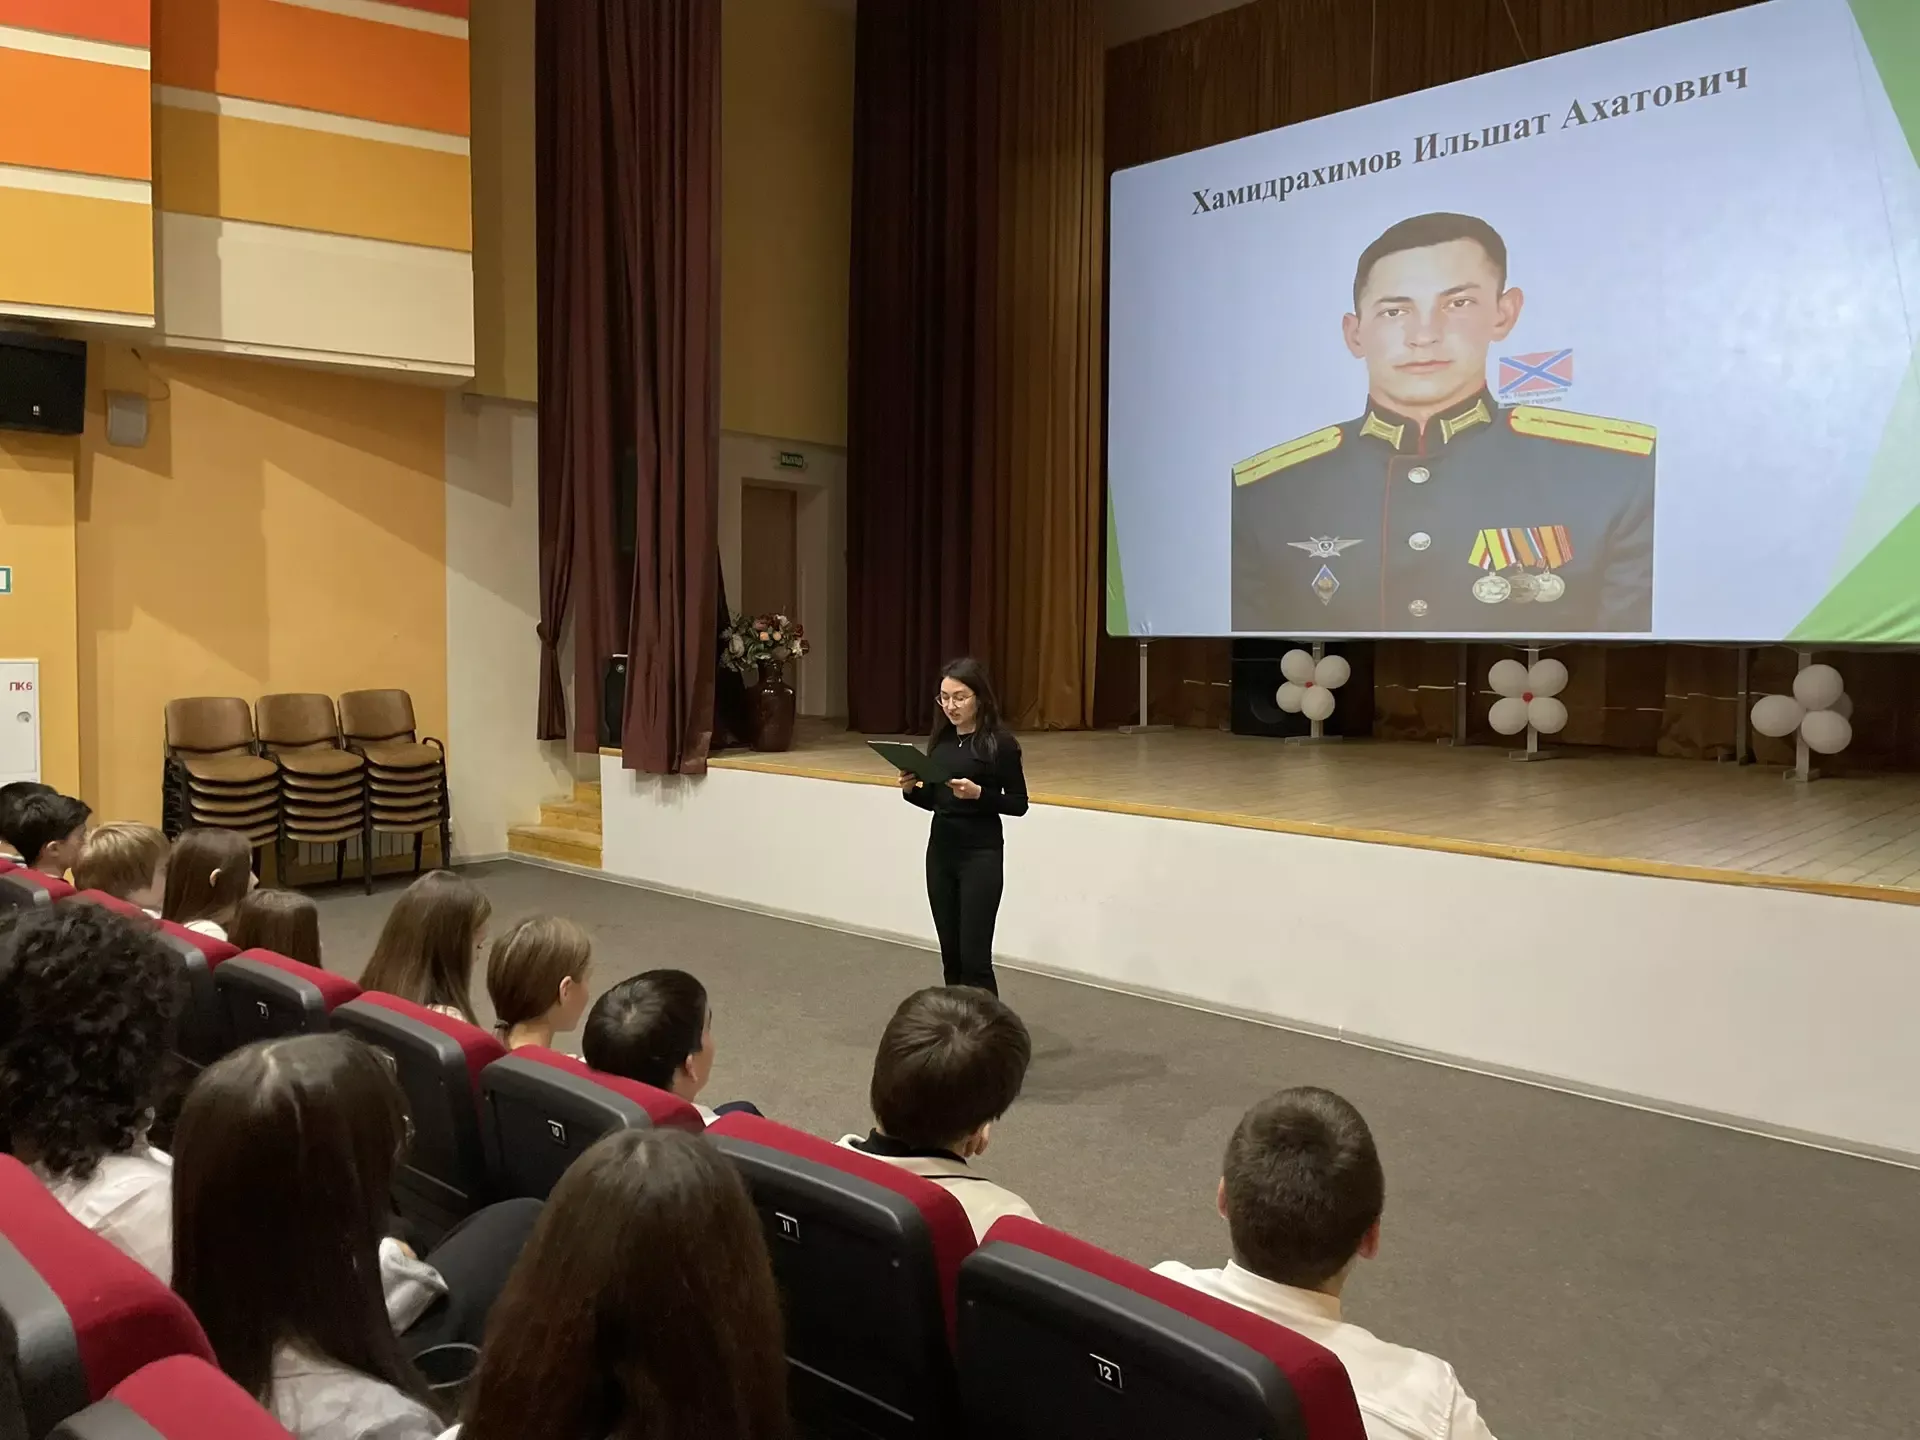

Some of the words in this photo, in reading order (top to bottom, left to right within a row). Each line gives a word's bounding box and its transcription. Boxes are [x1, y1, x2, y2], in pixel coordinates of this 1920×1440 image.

[1192, 149, 1402, 215] Хамидрахимов
[1413, 113, 1551, 164] Ильшат
[1561, 67, 1748, 130] Ахатович
[782, 1219, 791, 1233] 11
[1098, 1362, 1113, 1381] 12
